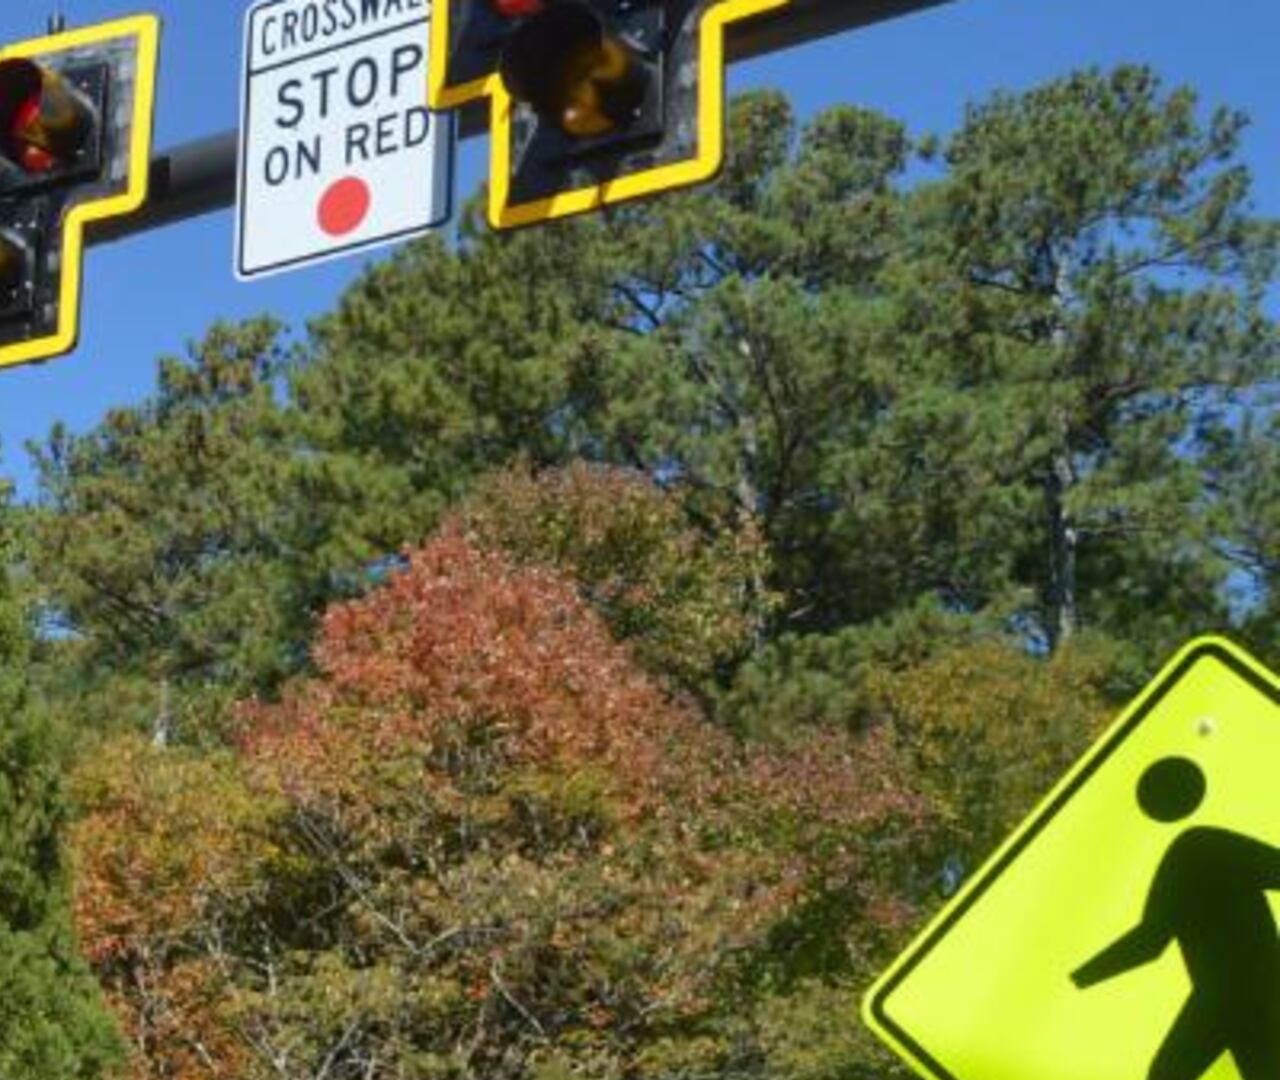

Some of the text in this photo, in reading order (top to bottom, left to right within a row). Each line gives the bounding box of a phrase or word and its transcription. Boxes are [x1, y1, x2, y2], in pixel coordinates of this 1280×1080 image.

[261, 0, 431, 56] CROSSW
[274, 43, 423, 129] STOP
[263, 106, 431, 187] ON RED
